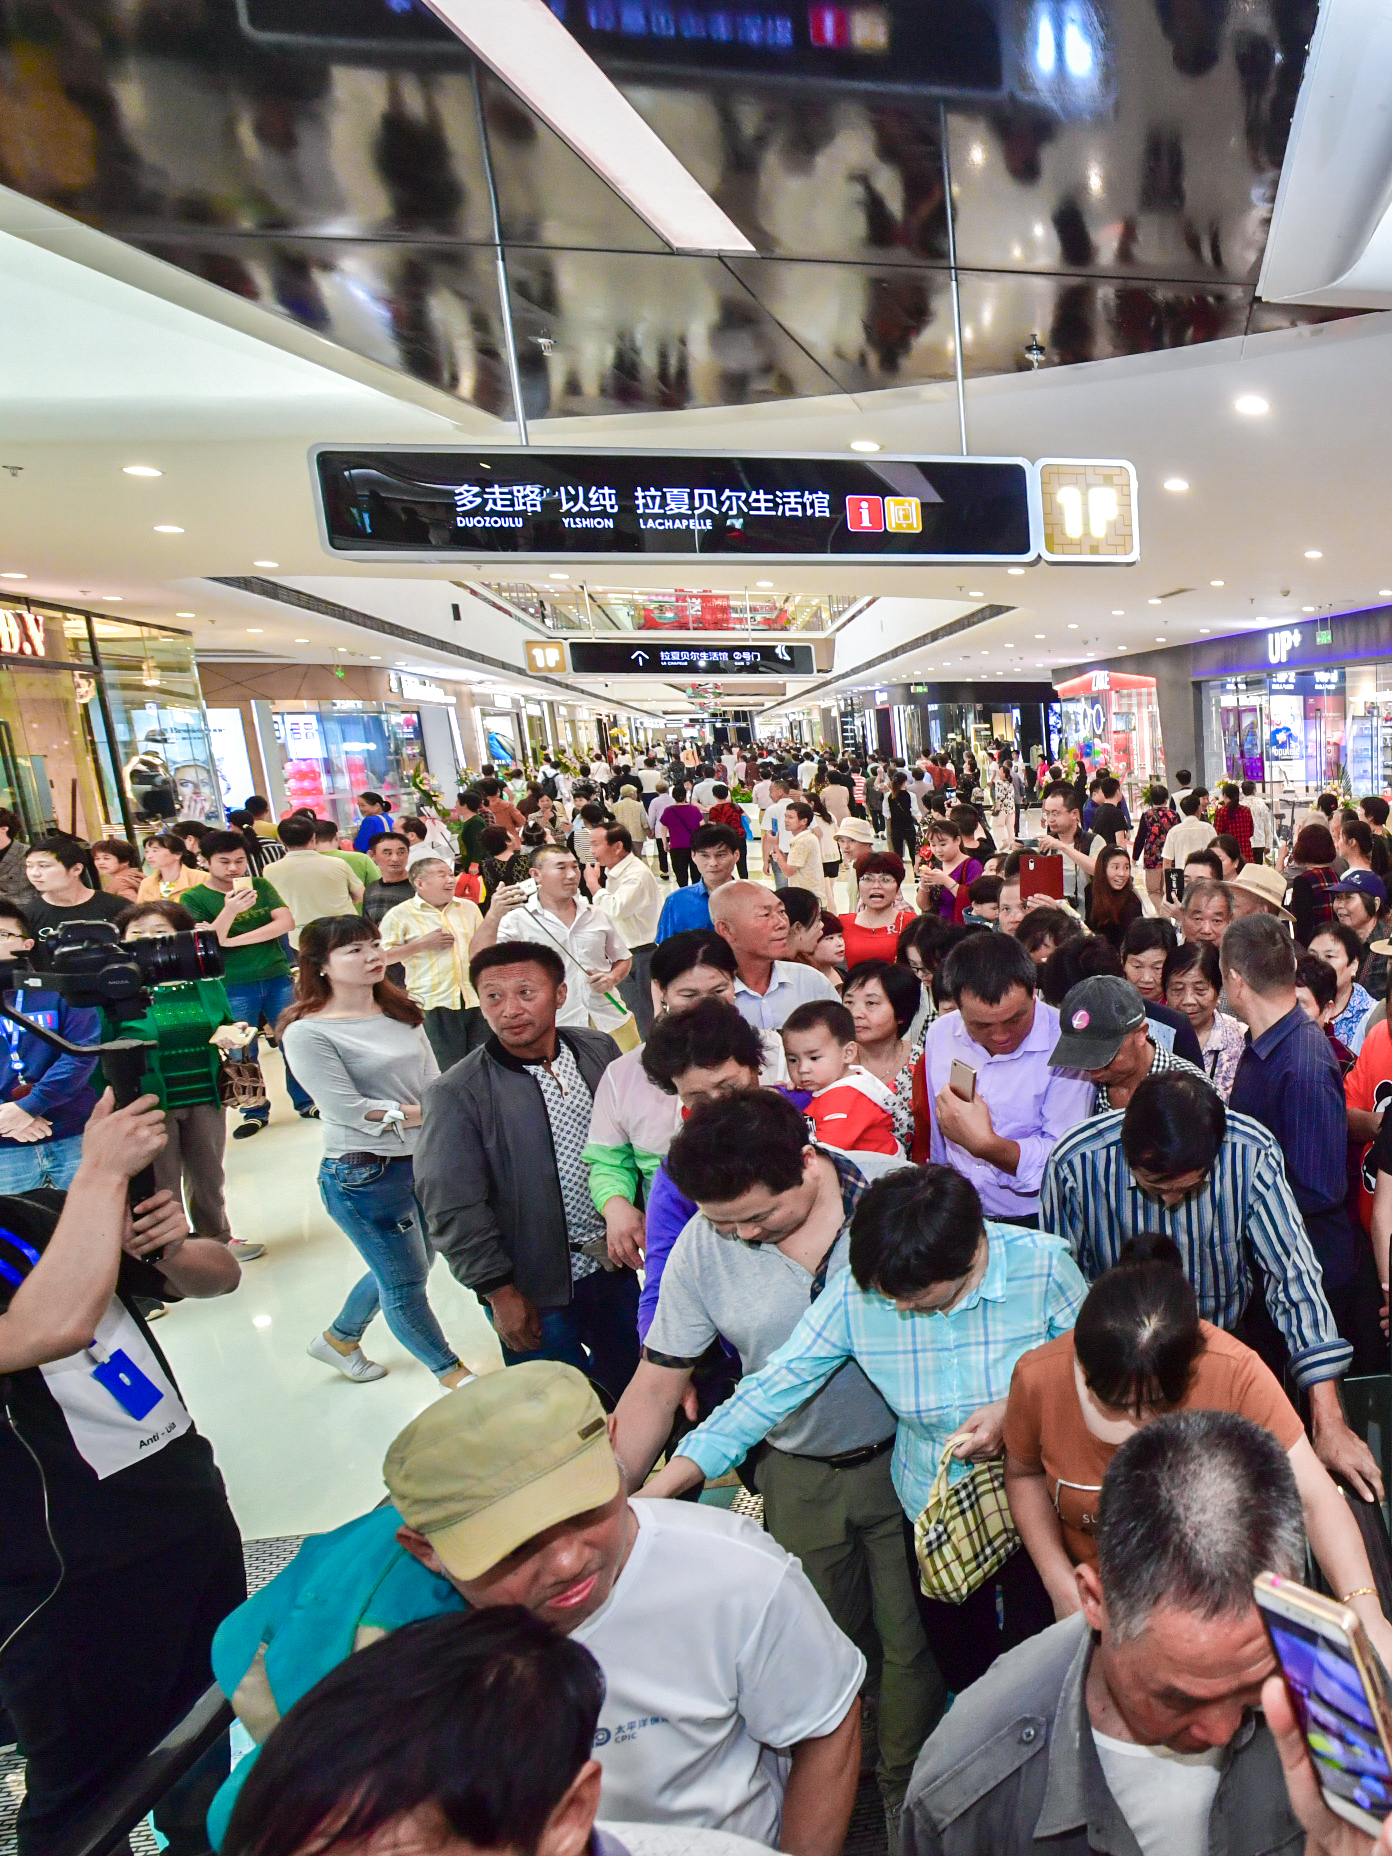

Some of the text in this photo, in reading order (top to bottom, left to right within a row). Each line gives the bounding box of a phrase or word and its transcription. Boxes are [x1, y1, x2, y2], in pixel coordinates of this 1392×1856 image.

[454, 484, 831, 517] 多走路 以纯 拉夏贝尔生活馆
[1056, 486, 1119, 538] 1F
[456, 516, 523, 528] DUOZOULU
[639, 518, 713, 530] LACHAPELLE
[531, 648, 560, 668] 1F
[660, 651, 728, 661] 拉夏贝尔生活馆
[139, 1432, 160, 1450] Anti
[614, 1731, 638, 1744] CPIC
